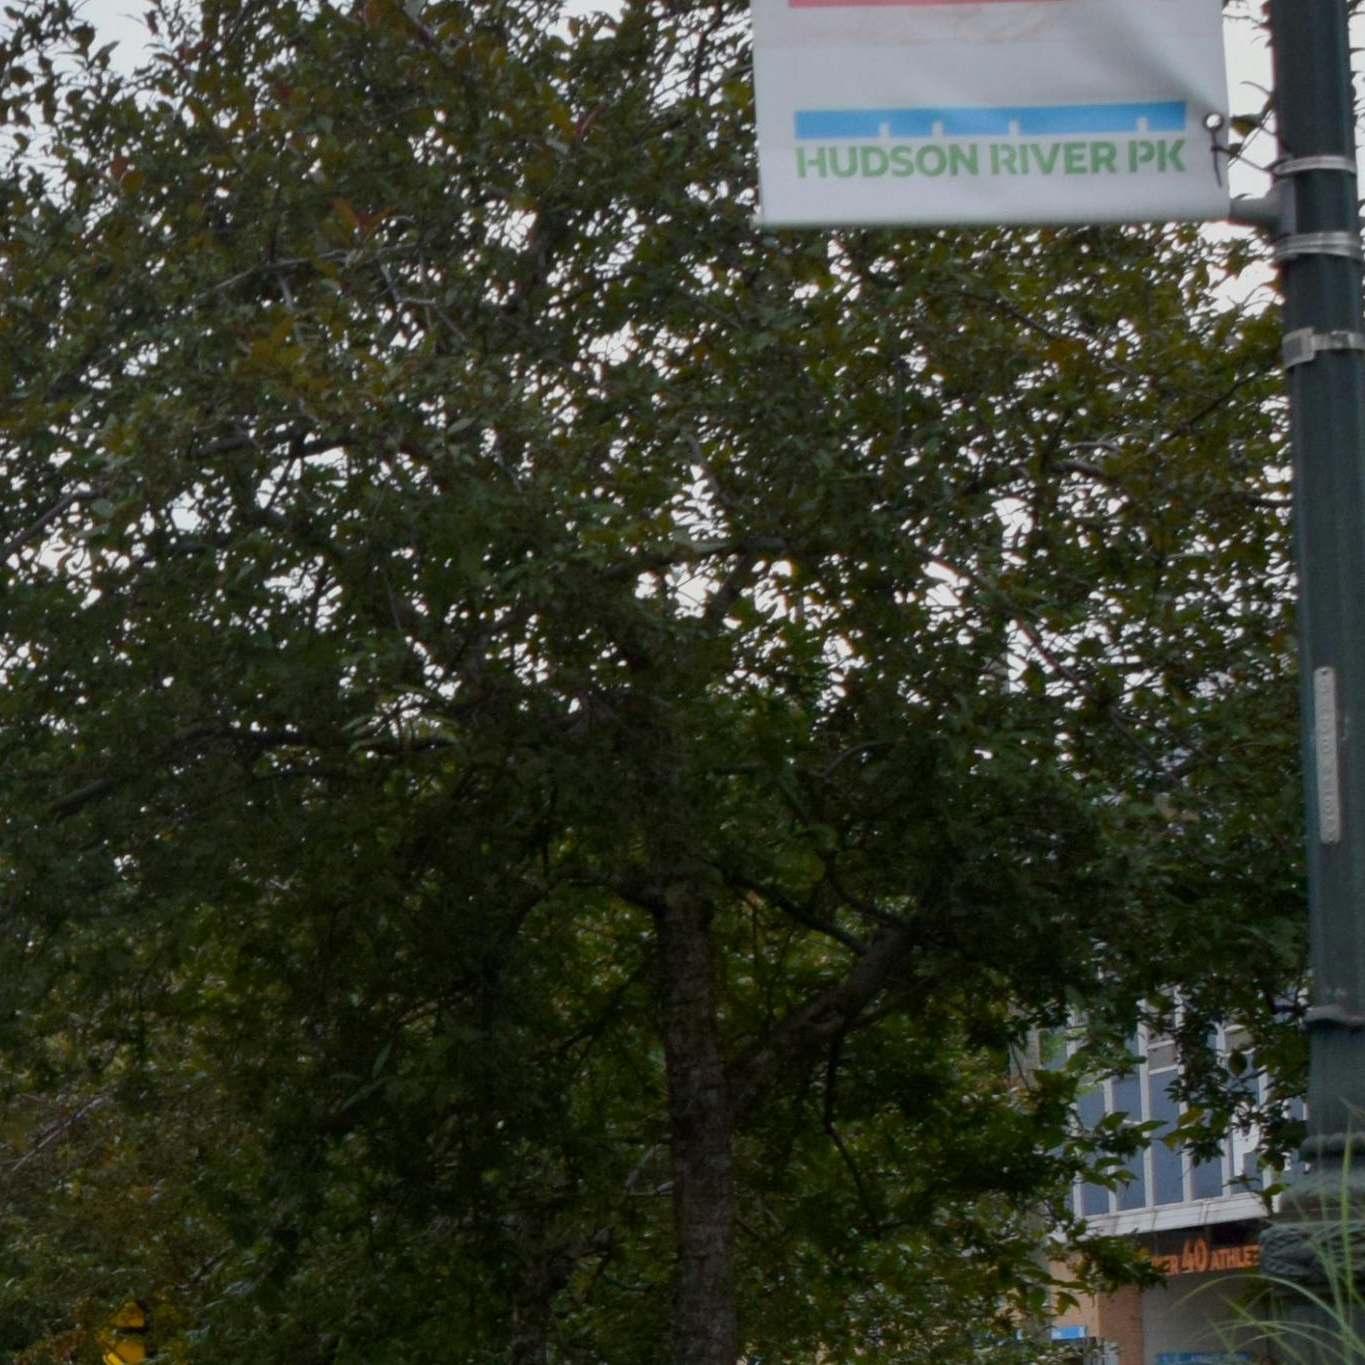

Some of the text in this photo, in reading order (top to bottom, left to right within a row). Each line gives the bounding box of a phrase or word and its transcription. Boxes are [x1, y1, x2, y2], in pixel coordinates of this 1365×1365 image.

[796, 138, 1187, 178] HUDSON RIVER PK
